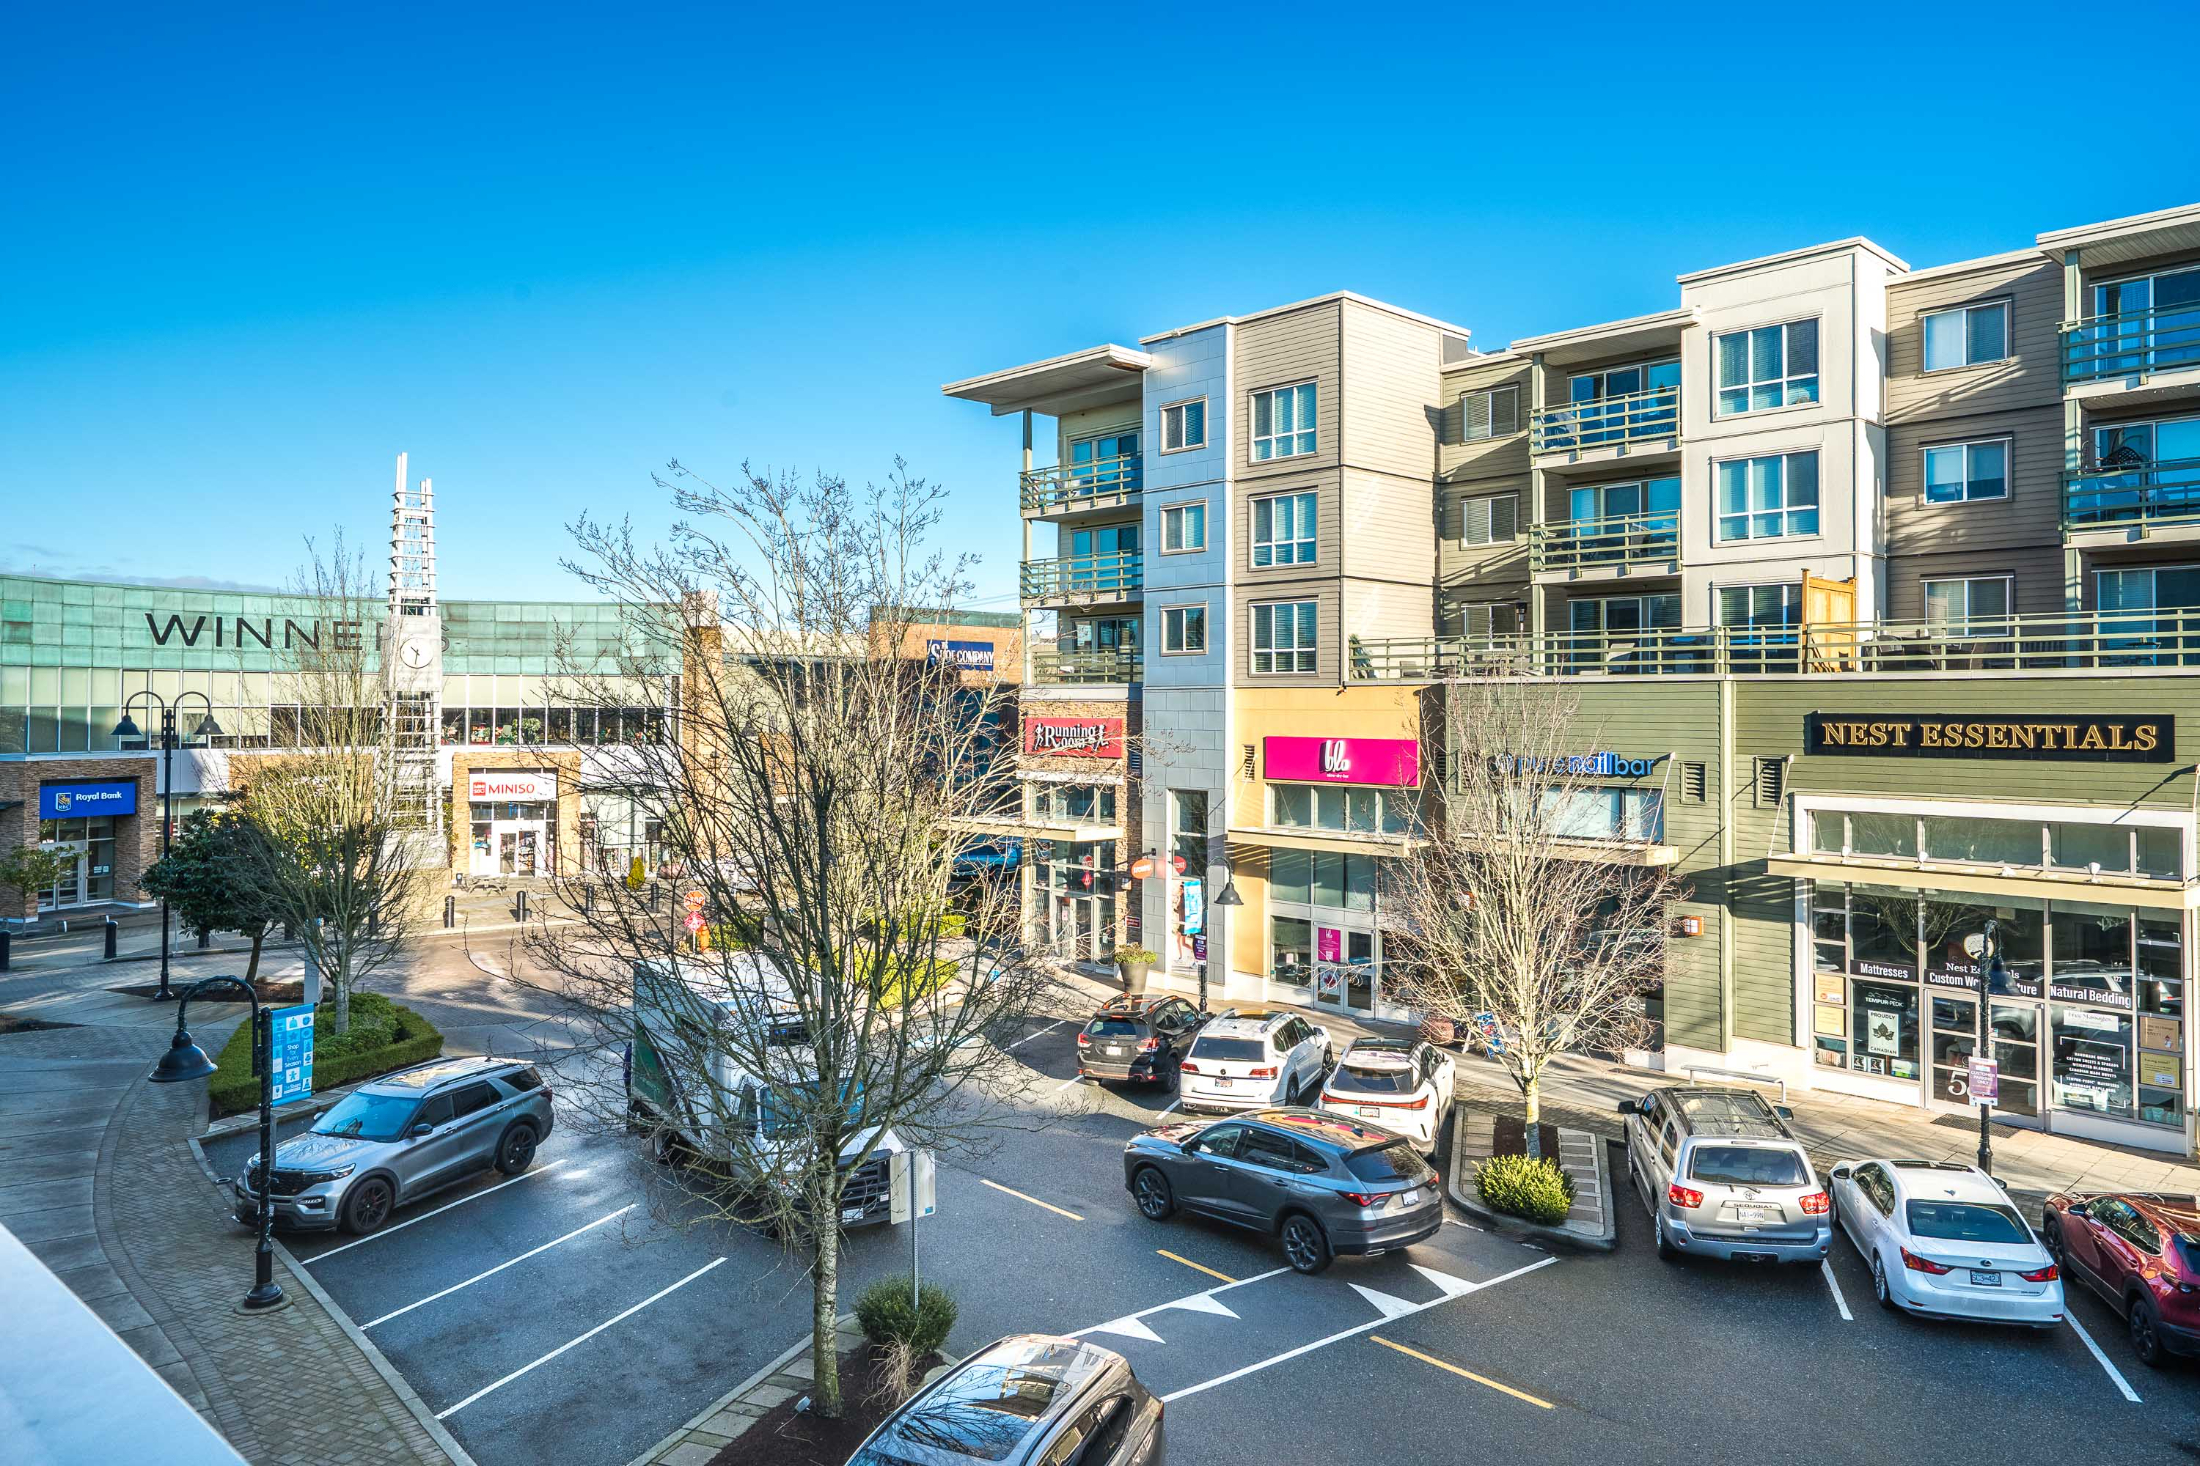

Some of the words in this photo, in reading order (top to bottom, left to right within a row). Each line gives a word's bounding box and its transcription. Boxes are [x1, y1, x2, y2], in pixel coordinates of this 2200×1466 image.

[145, 612, 450, 652] WINNE
[957, 649, 994, 665] COMPANY
[1044, 723, 1097, 748] Running
[1822, 722, 1910, 746] NEST
[1920, 723, 2157, 750] ESSENTIALS
[1324, 739, 1350, 772] blo
[76, 792, 100, 802] Royal
[101, 791, 123, 800] Bank
[488, 783, 535, 794] MINISO
[1860, 962, 1909, 979] Mattresses
[1945, 962, 1968, 974] Nest
[1929, 972, 1963, 986] Custom
[2050, 985, 2089, 1001] Natural
[2089, 989, 2132, 1009] Bedding
[1870, 1012, 1896, 1021] PROUDLY
[1870, 1046, 1897, 1055] CANADIAN
